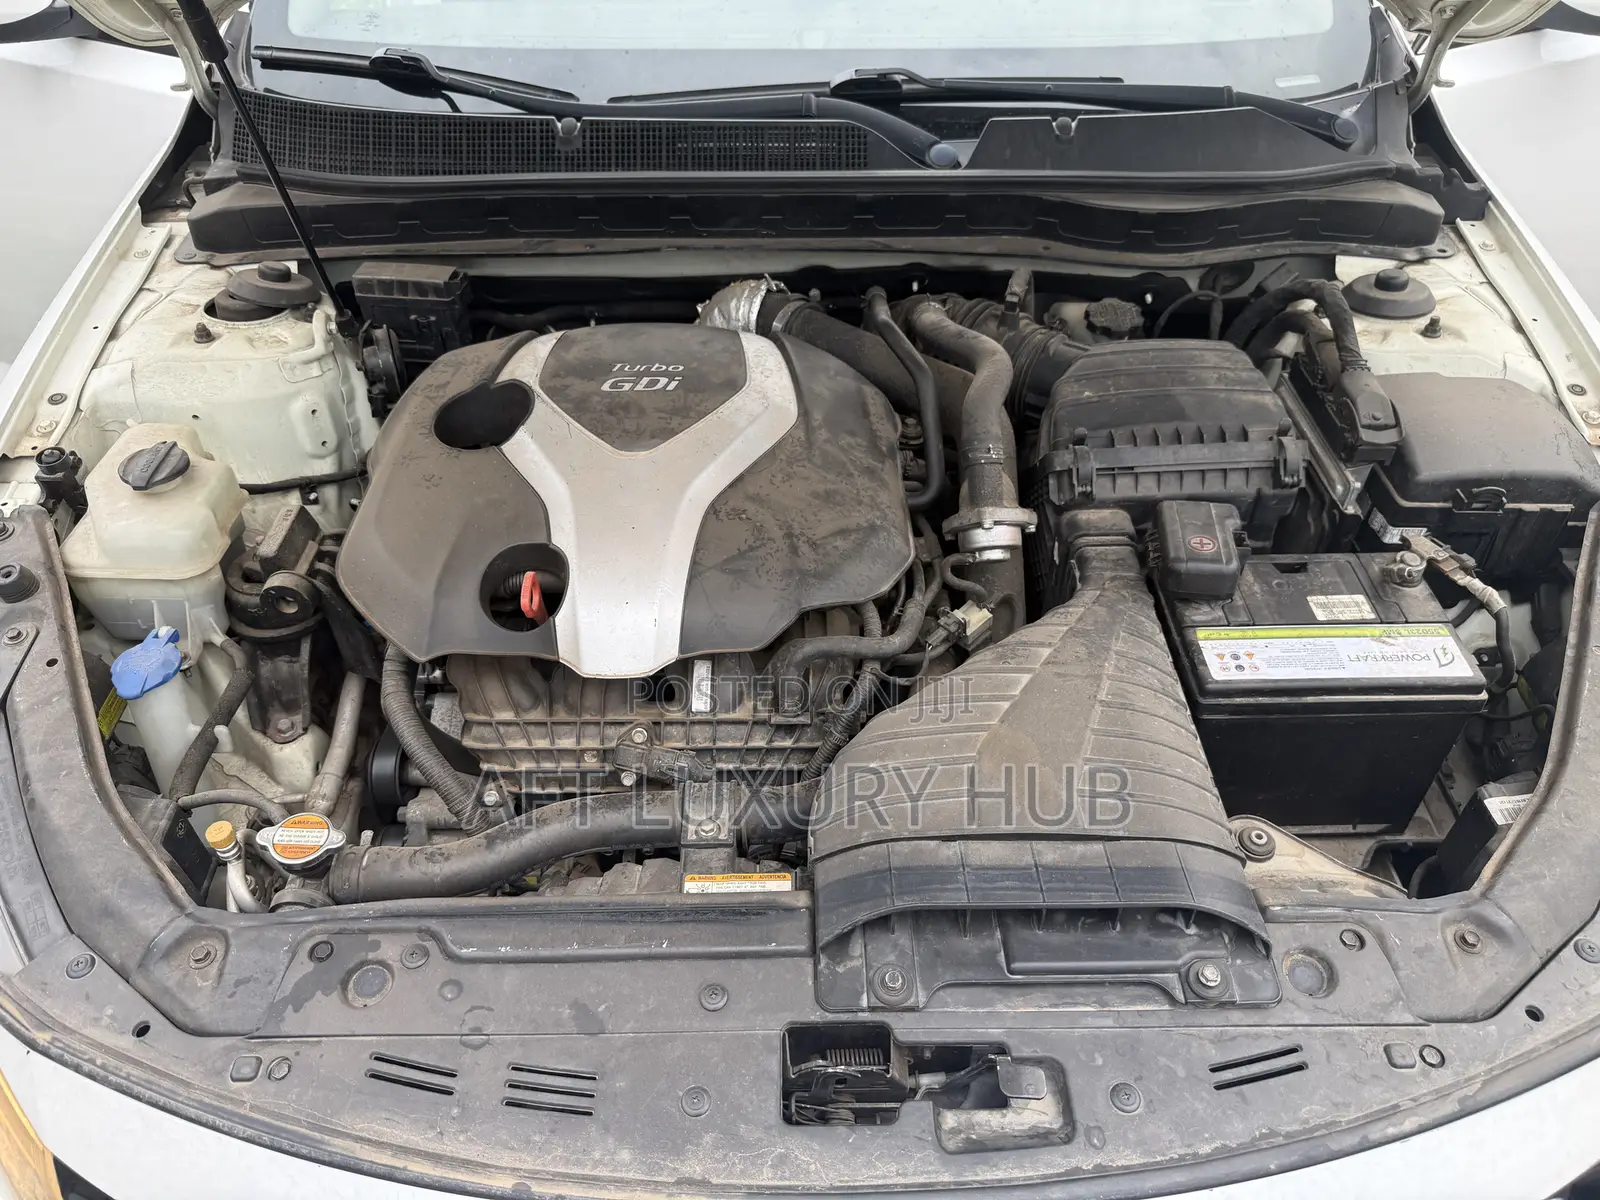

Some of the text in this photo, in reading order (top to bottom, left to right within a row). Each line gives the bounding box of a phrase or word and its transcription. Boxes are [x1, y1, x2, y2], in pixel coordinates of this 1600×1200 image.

[609, 363, 684, 371] Turbo
[600, 376, 683, 392] GDi
[1347, 653, 1431, 662] POWERKRAFT
